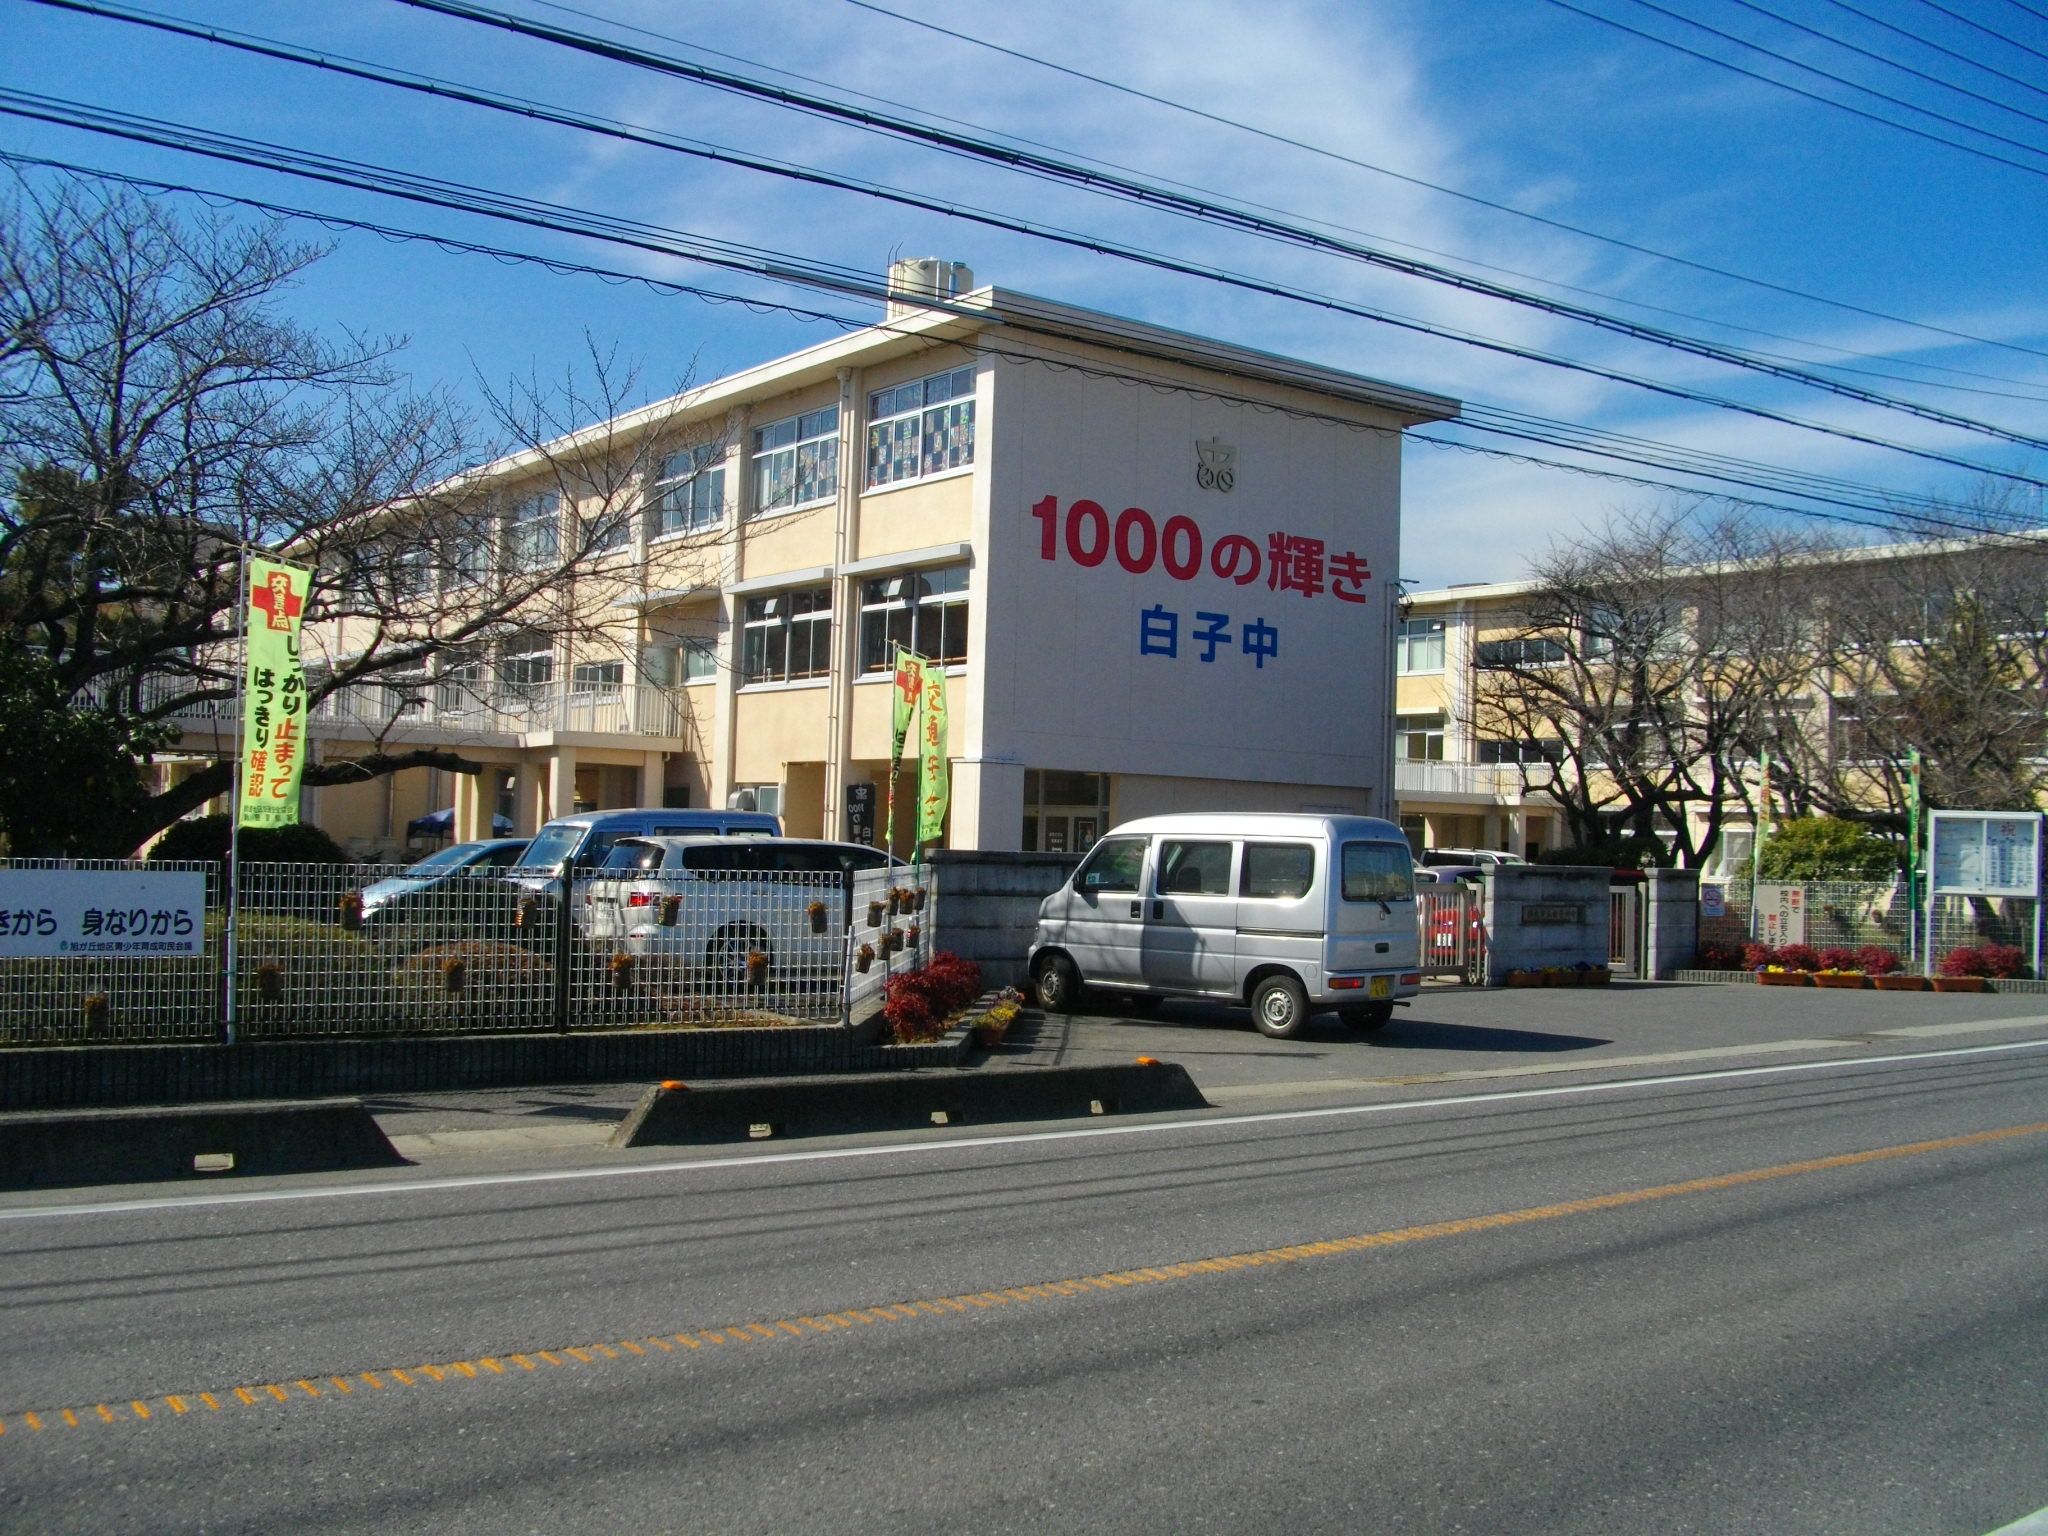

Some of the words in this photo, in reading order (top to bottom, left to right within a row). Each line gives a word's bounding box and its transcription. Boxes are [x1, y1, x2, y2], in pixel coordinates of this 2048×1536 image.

[1032, 494, 1372, 604] 1000の輝き
[1140, 604, 1278, 669] 白子中
[248, 666, 276, 798] はっきり確認
[82, 908, 193, 936] 身なりから
[1779, 890, 1789, 948] 校内への立ち入り
